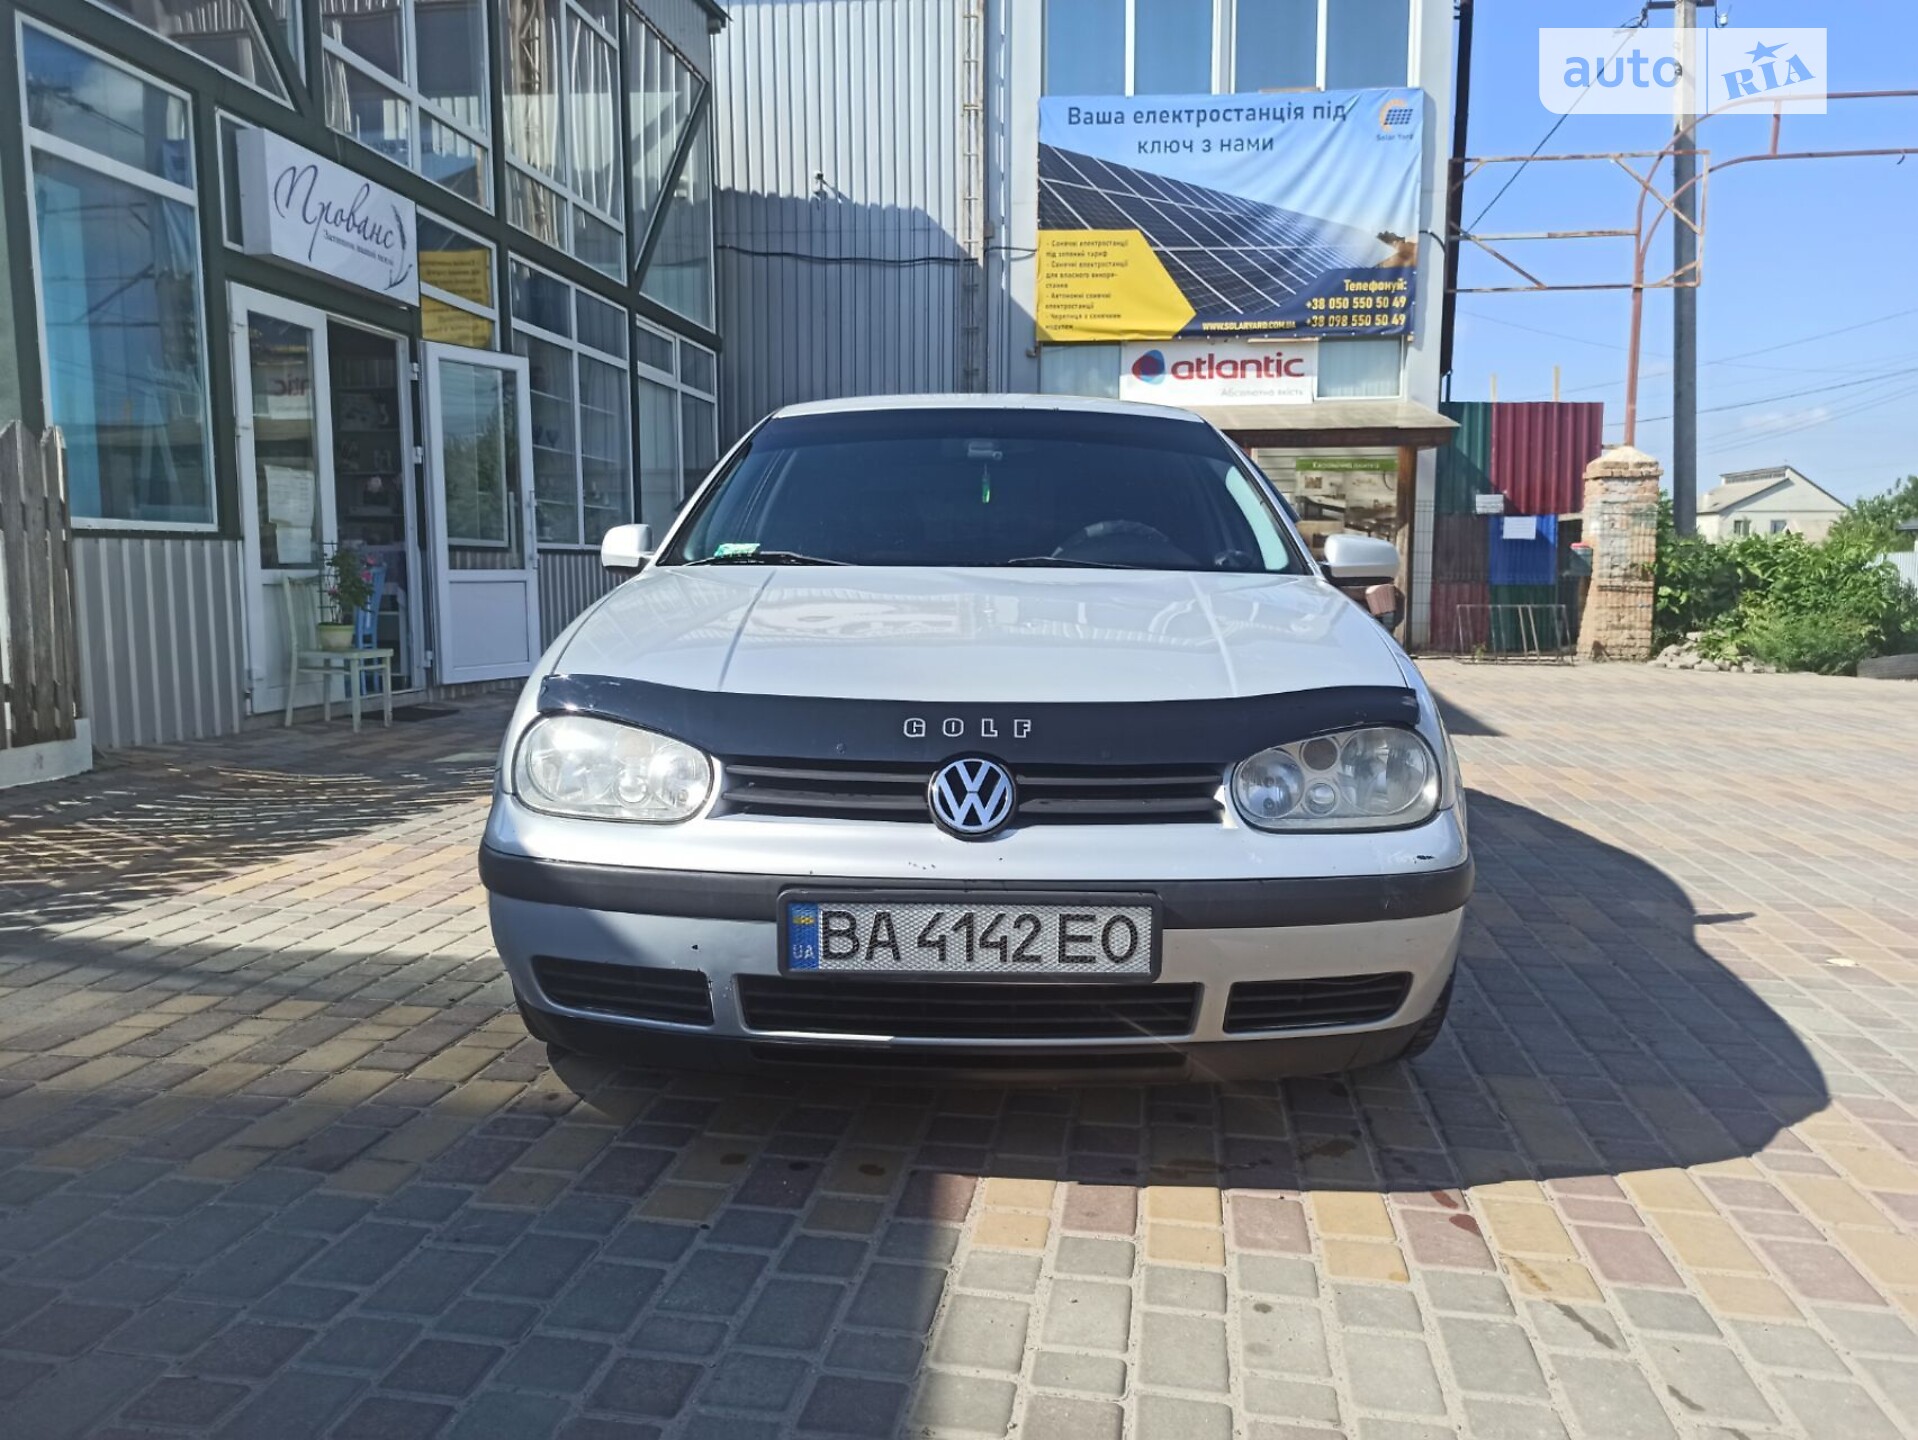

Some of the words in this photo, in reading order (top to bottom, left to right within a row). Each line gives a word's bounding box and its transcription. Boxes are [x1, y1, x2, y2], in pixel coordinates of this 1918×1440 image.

[1067, 106, 1126, 126] Ваша
[1133, 101, 1304, 128] електростанція
[1313, 101, 1347, 121] під
[1138, 139, 1194, 154] ключ
[1202, 139, 1212, 153] з
[1220, 137, 1274, 152] нами
[1344, 279, 1407, 293] Телефонуй:
[1306, 298, 1325, 310] +38
[1329, 297, 1349, 309] 050
[1353, 297, 1373, 309] 550
[1376, 296, 1389, 308] 50
[1392, 296, 1406, 308] 49
[1306, 315, 1325, 327] +38
[1328, 315, 1348, 327] 098
[1351, 315, 1371, 327] 550
[1375, 314, 1388, 326] 50
[1391, 314, 1406, 325] 49
[1171, 351, 1305, 380] atlantic
[903, 717, 1032, 739] GOLF
[820, 910, 900, 961] BA
[917, 911, 1042, 964] 4142
[1058, 913, 1138, 965] EO
[792, 944, 815, 960] UA
